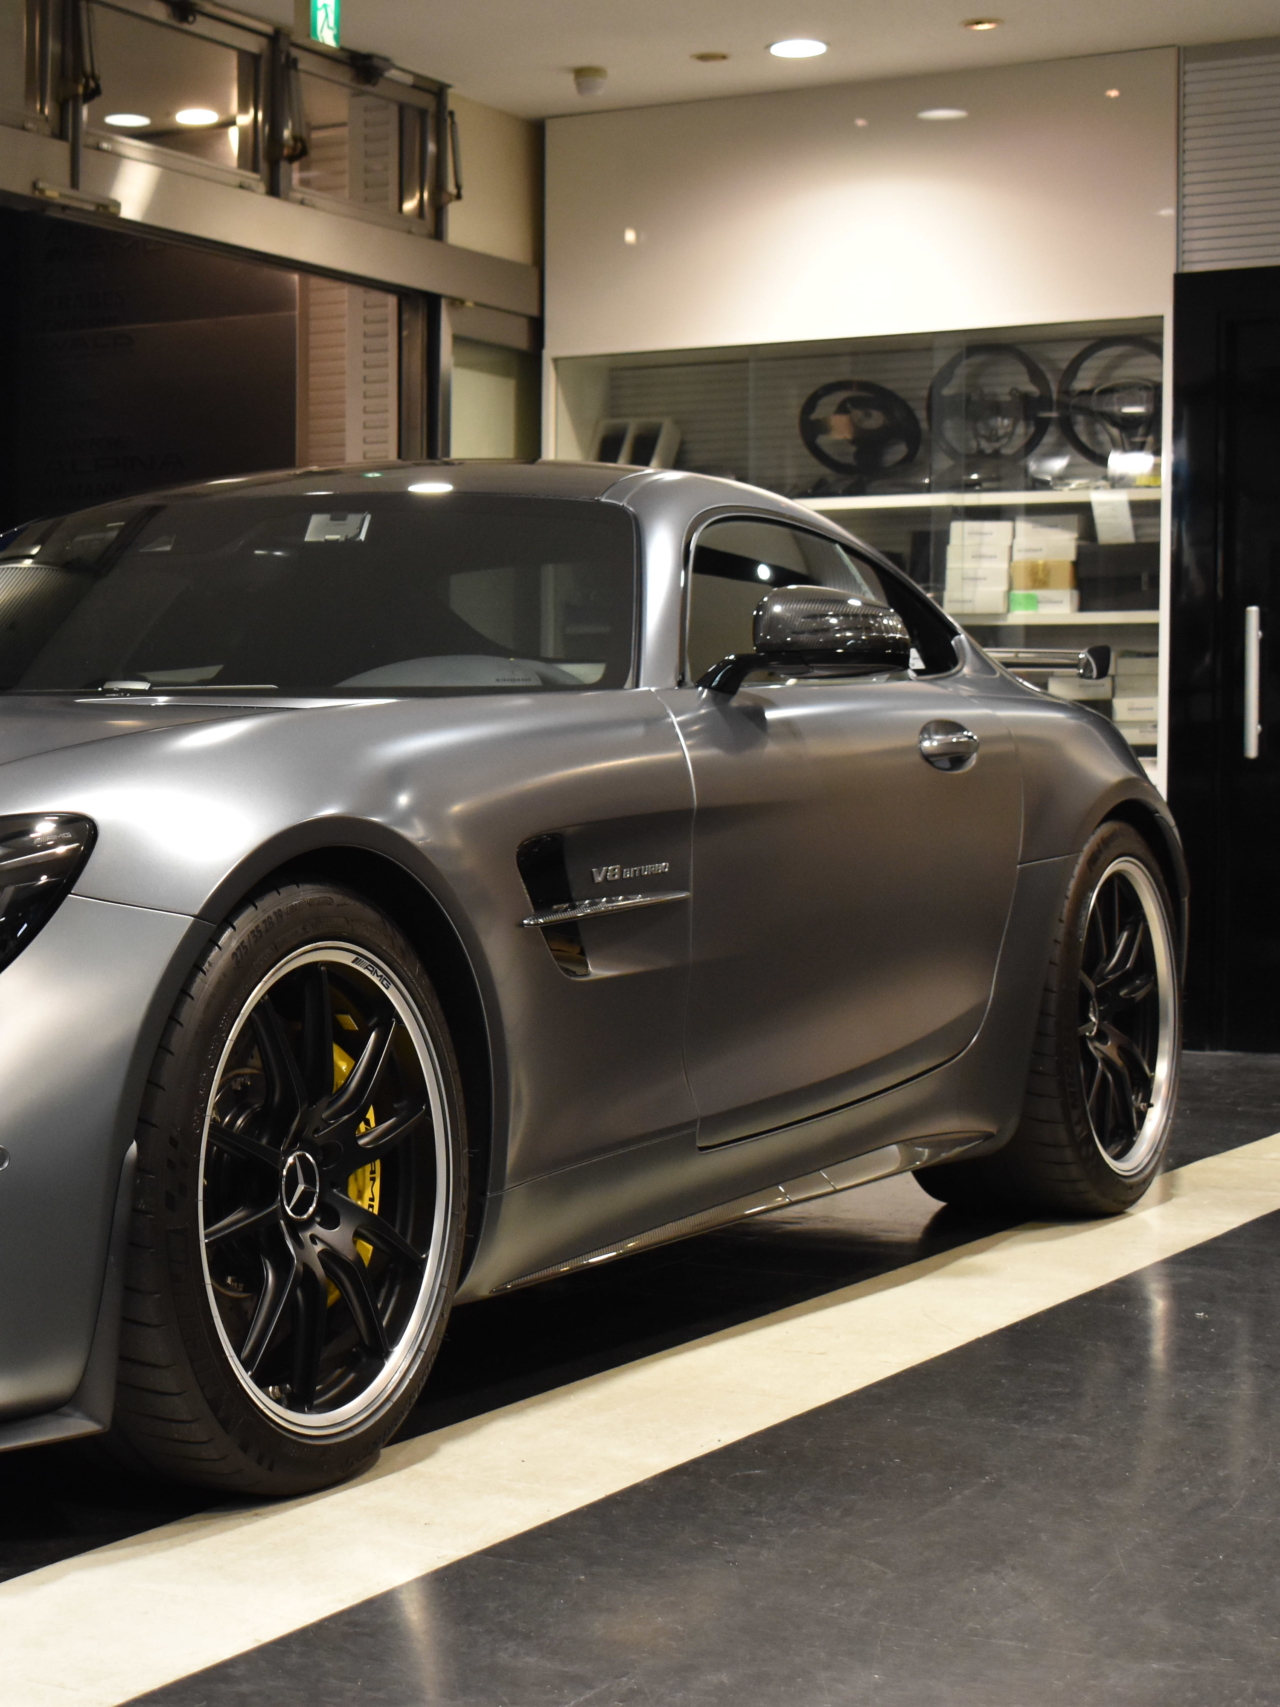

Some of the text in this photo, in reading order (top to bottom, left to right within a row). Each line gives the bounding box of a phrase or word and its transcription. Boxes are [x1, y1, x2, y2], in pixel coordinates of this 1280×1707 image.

[592, 862, 669, 883] V8 BITURBO
[364, 964, 391, 990] AMG
